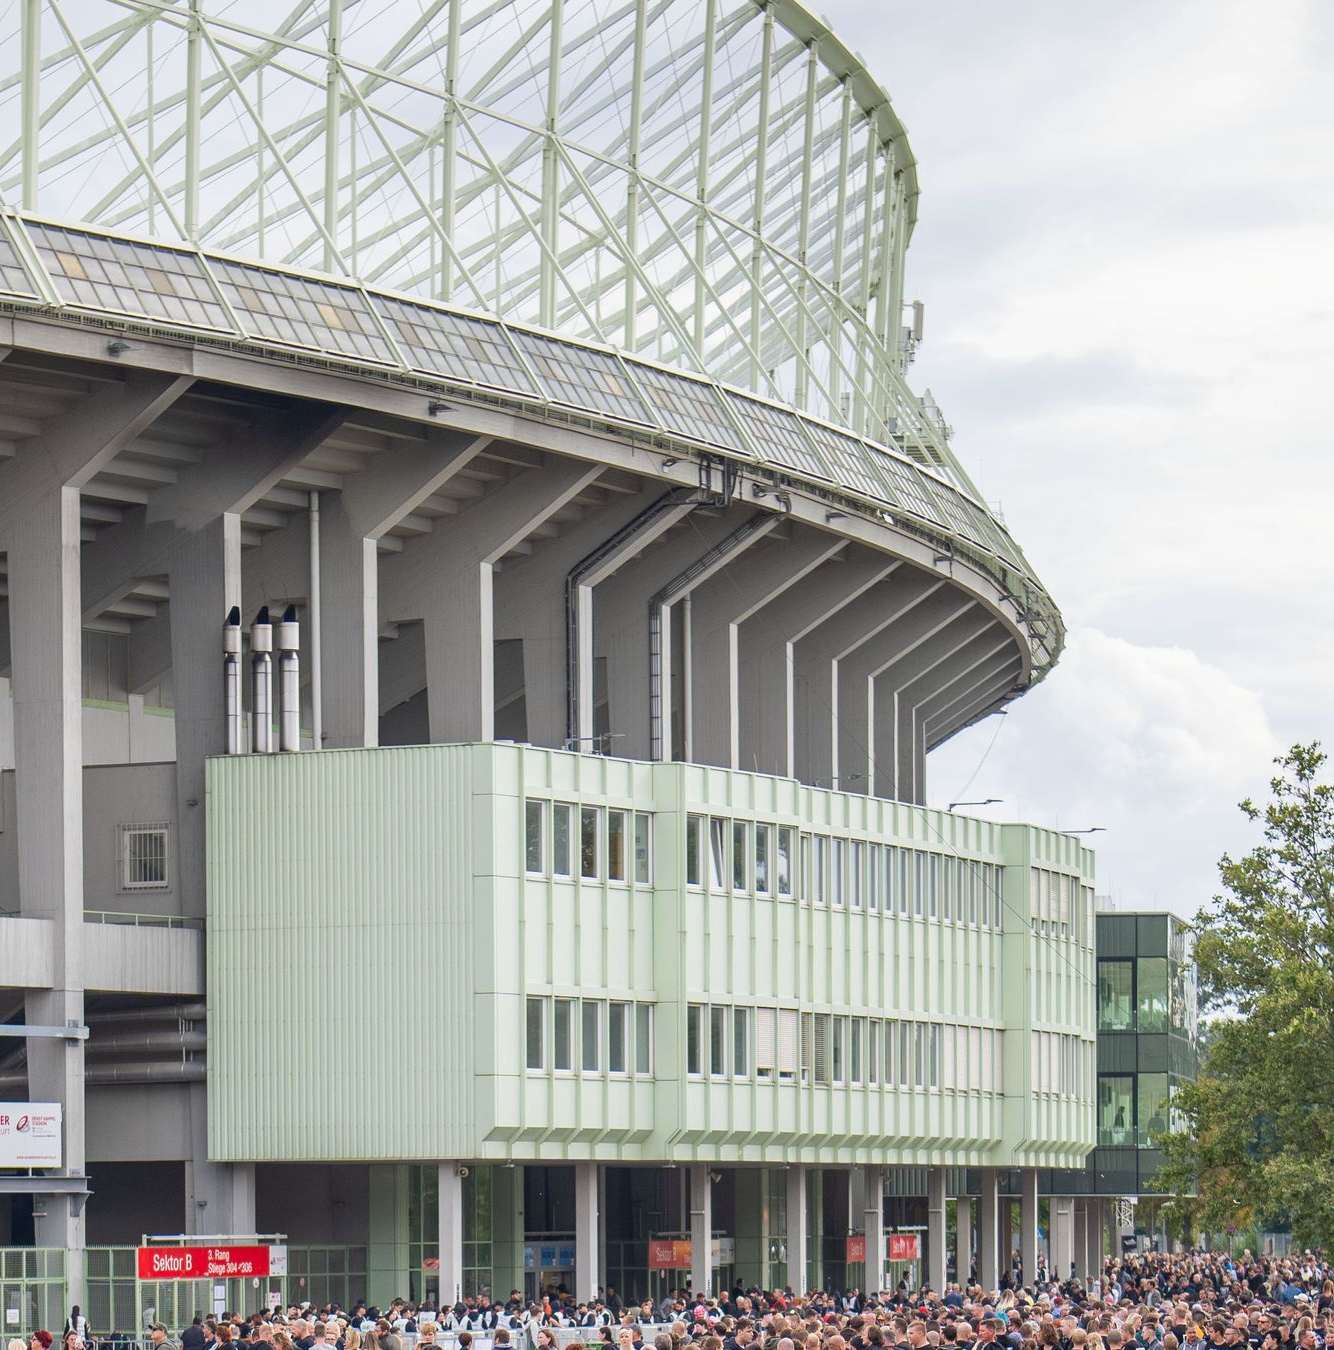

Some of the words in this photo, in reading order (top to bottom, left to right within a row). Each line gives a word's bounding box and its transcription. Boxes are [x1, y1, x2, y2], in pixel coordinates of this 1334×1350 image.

[208, 1250, 214, 1260] 3.
[215, 1250, 230, 1262] Rang
[656, 1247, 672, 1261] Sektor
[153, 1254, 182, 1271] Sektor
[186, 1254, 192, 1270] B
[208, 1263, 226, 1275] Stiege
